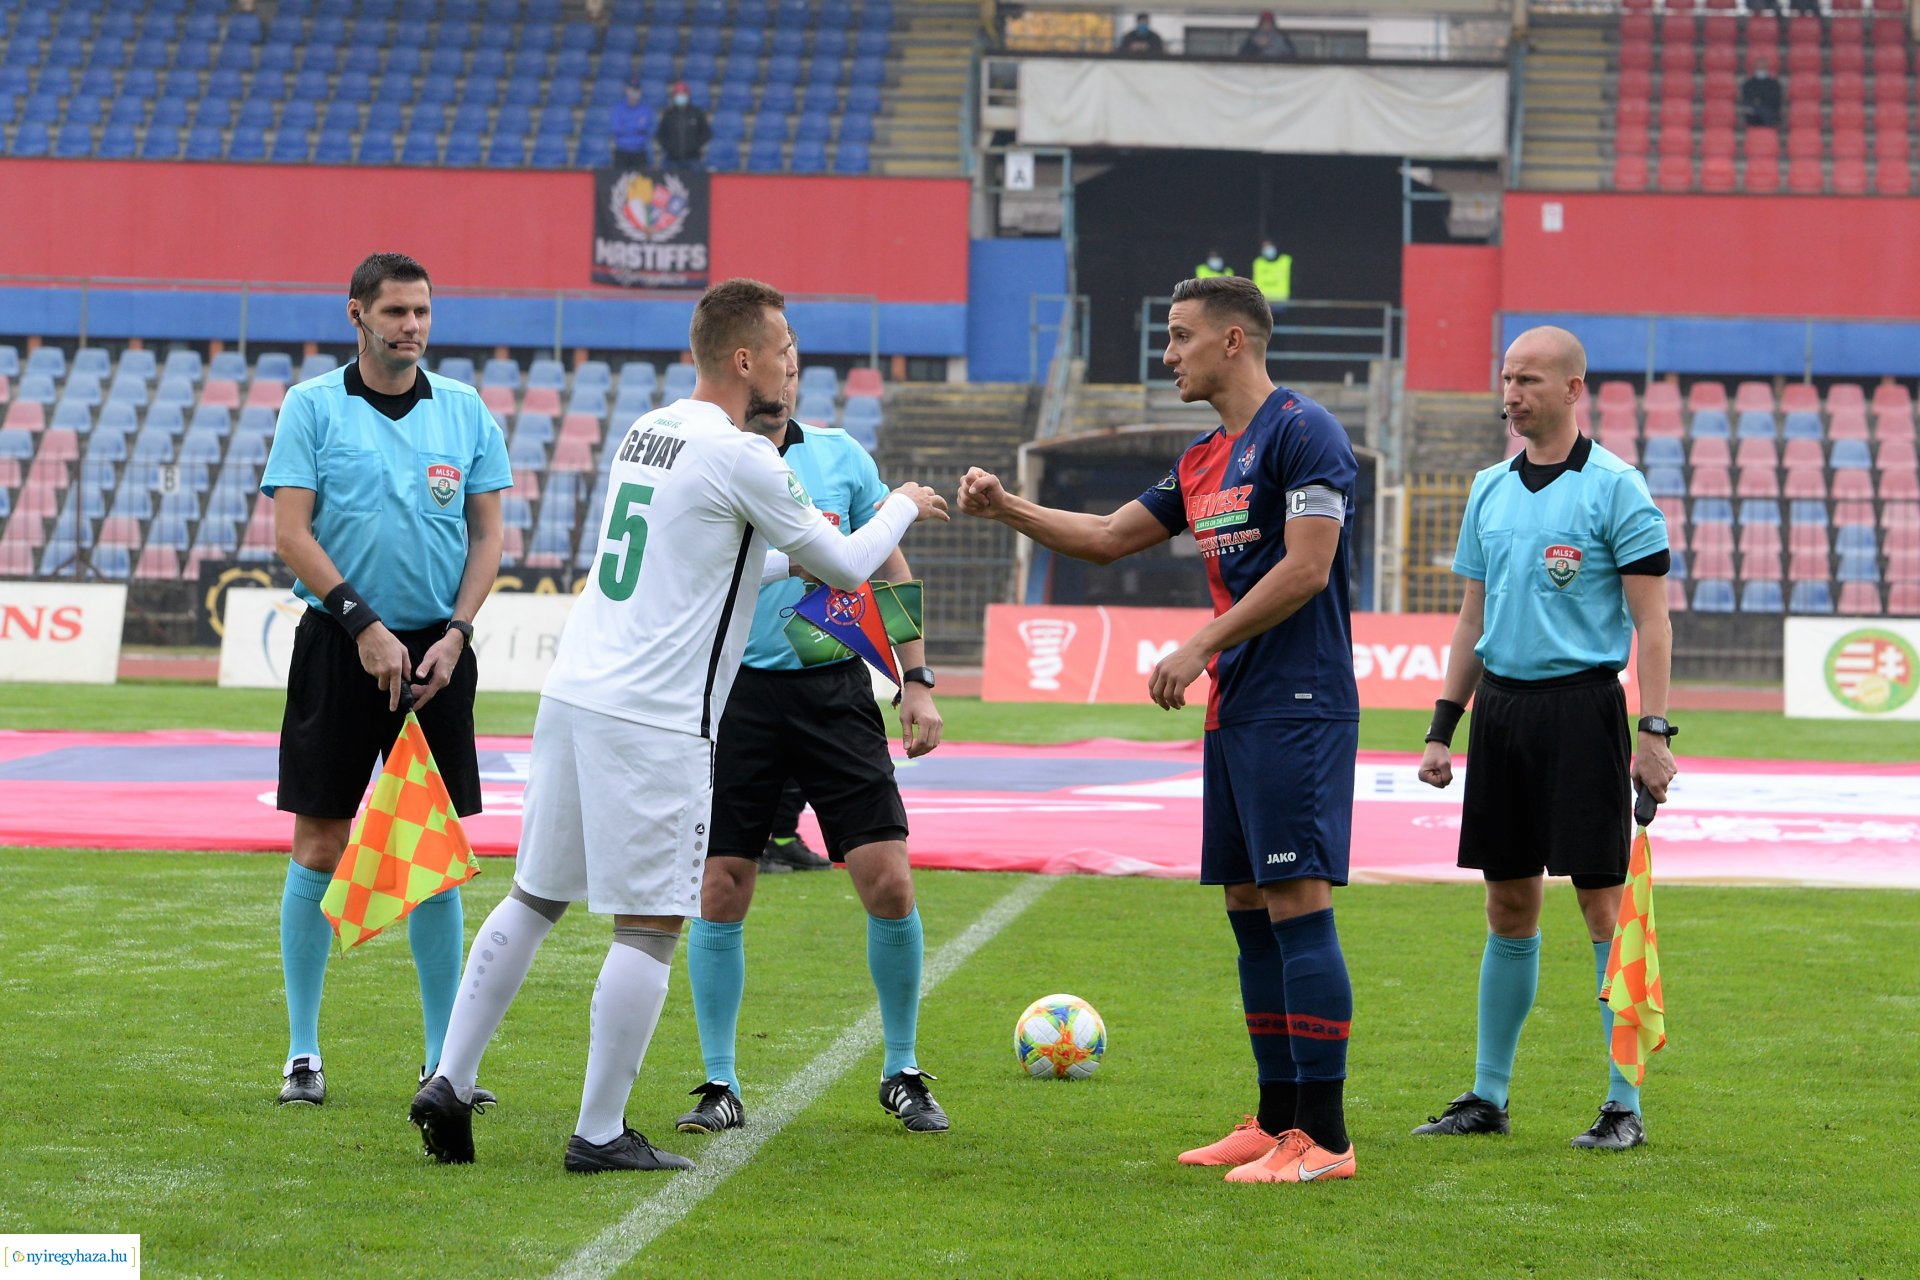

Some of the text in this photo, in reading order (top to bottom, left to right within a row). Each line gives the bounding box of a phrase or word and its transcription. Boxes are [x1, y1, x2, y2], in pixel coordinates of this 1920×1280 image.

[596, 238, 707, 270] MASTIFFS
[619, 428, 687, 470] GÉVAY
[435, 468, 455, 478] MLSZ
[1290, 491, 1307, 514] C
[598, 482, 655, 601] 5
[1219, 528, 1261, 547] TRANS
[1552, 549, 1575, 558] MLSZ
[1267, 852, 1297, 864] JAKO
